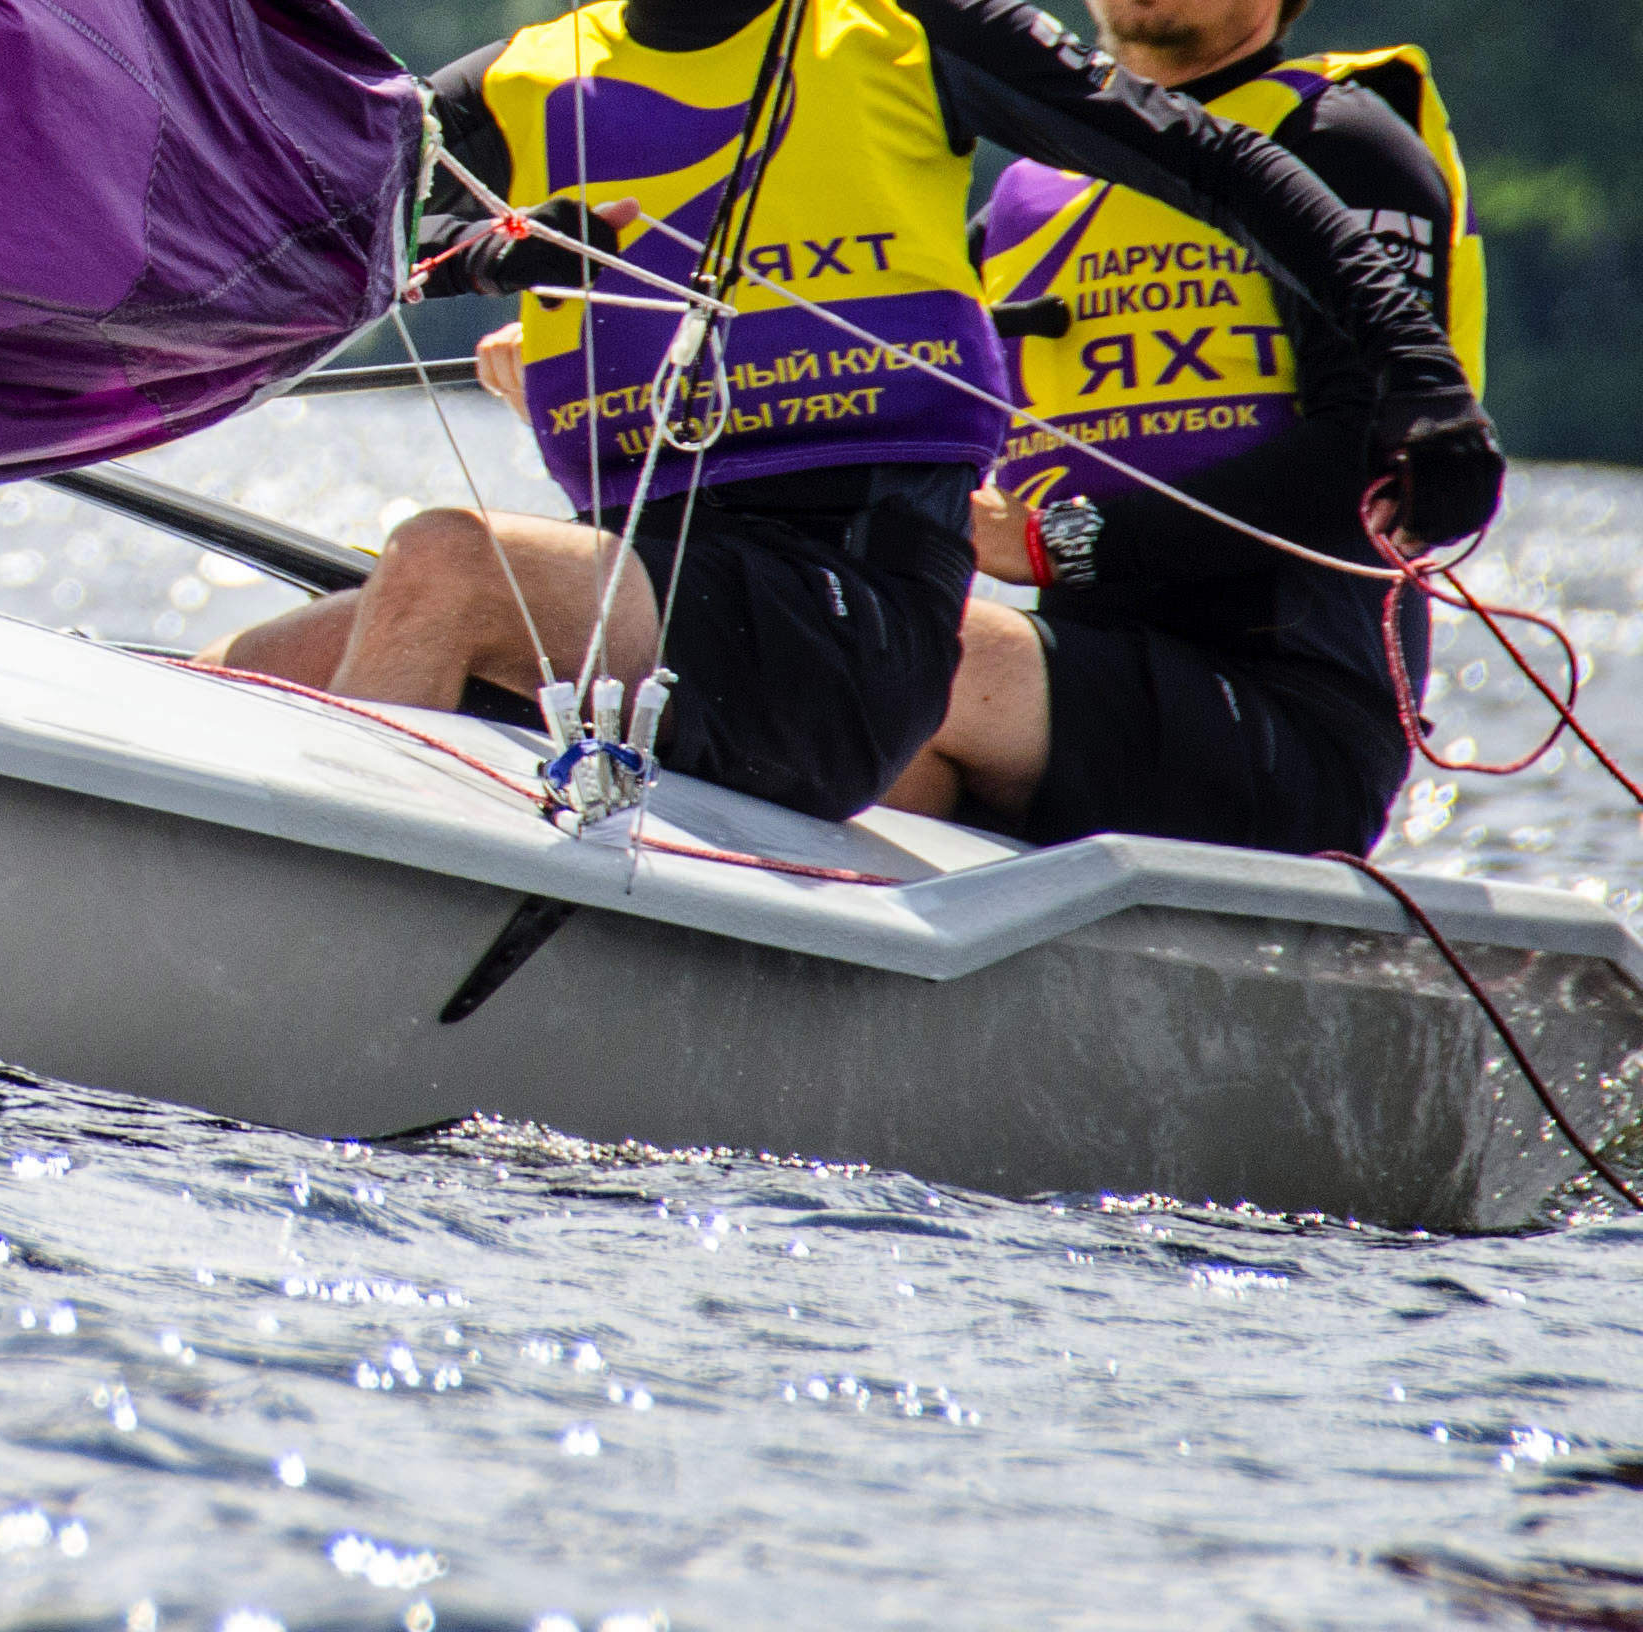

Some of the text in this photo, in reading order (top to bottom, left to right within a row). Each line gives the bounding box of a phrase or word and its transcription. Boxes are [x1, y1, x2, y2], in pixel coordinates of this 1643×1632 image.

[748, 232, 896, 287] ЯХТ
[1076, 278, 1240, 322] ШКОЛА
[828, 338, 962, 376] КУБОК
[1078, 325, 1287, 396] ЯХТ
[778, 386, 885, 425] 7ЯХТ
[1139, 403, 1260, 436] КУБОК
